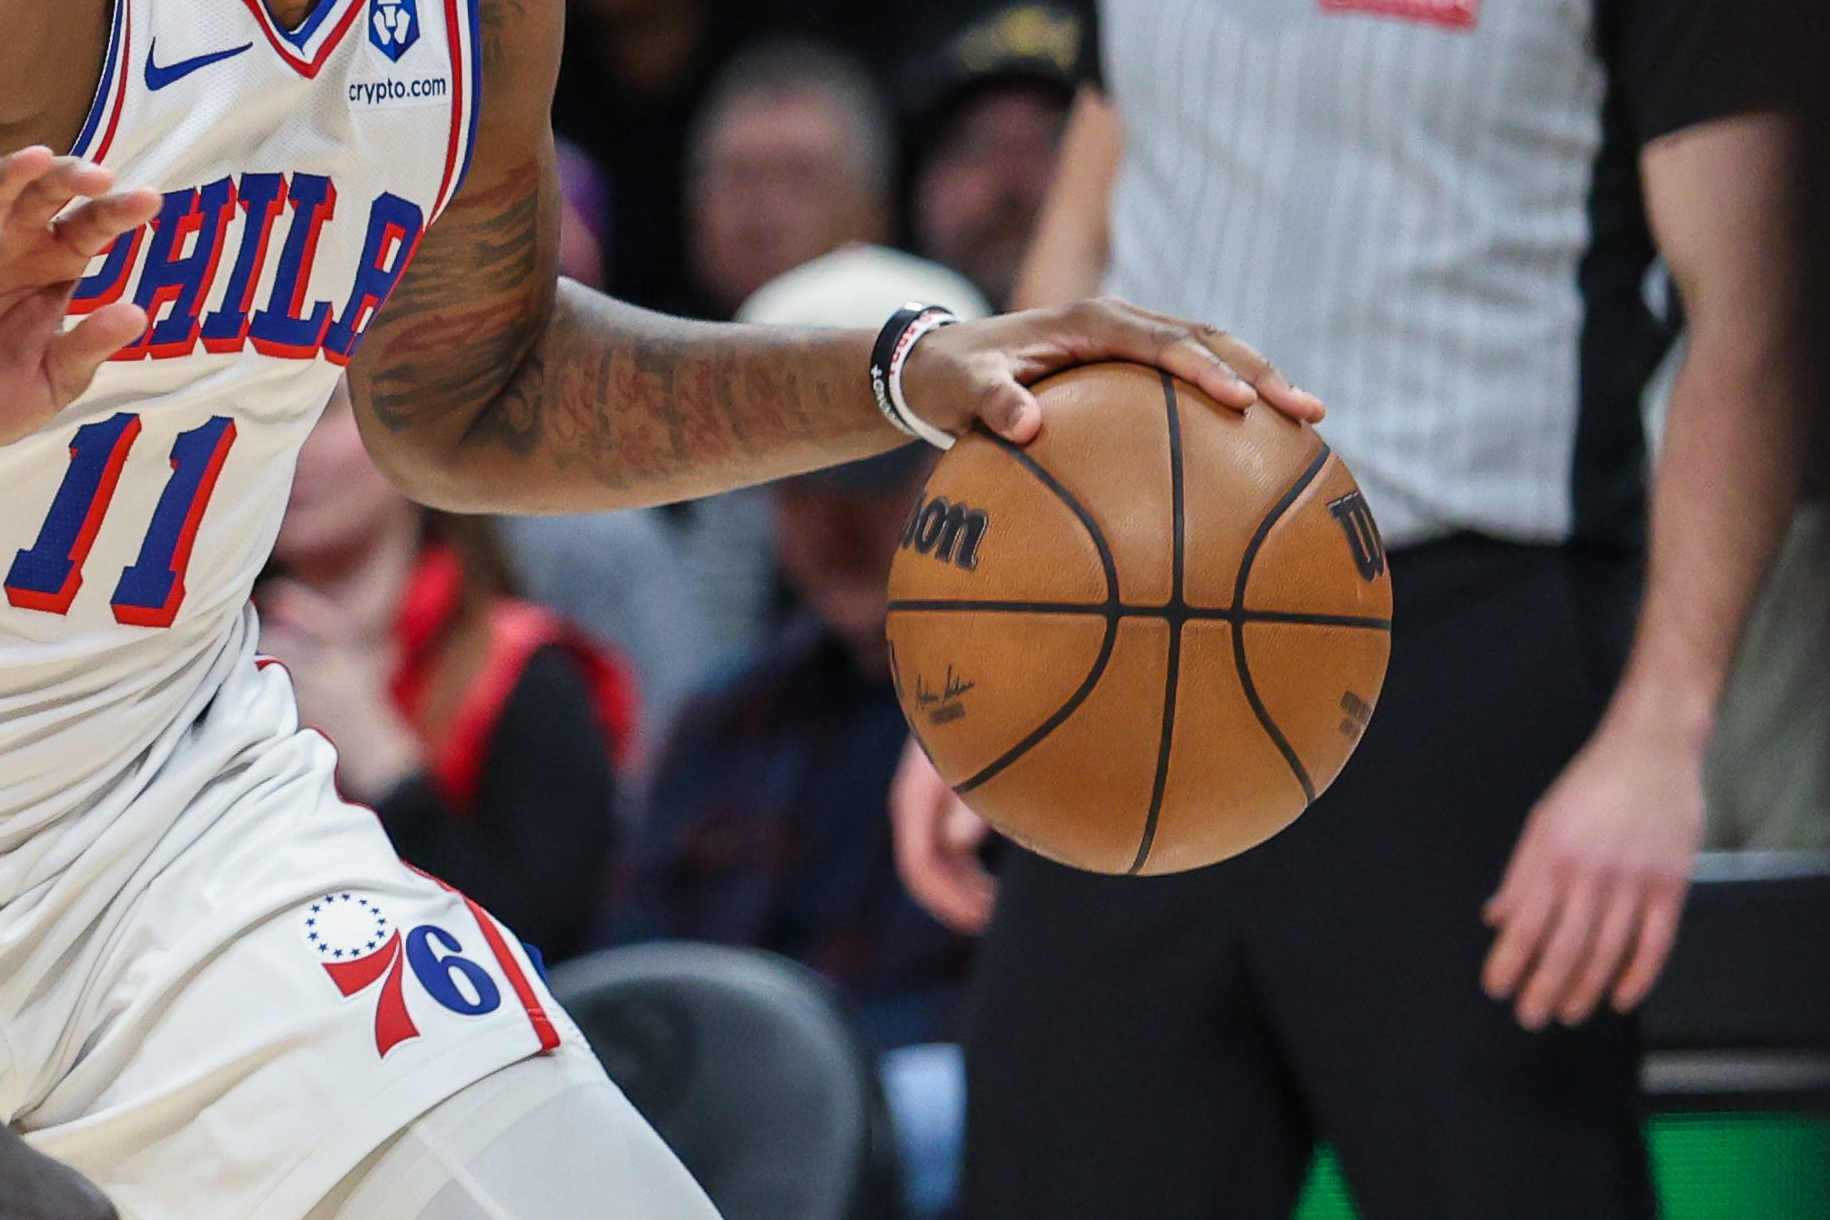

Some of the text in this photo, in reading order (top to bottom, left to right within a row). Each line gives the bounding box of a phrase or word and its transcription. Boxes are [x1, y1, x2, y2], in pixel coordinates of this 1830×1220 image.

[348, 77, 446, 105] crypto.com
[4, 412, 237, 628] 11
[321, 926, 501, 1059] 76
